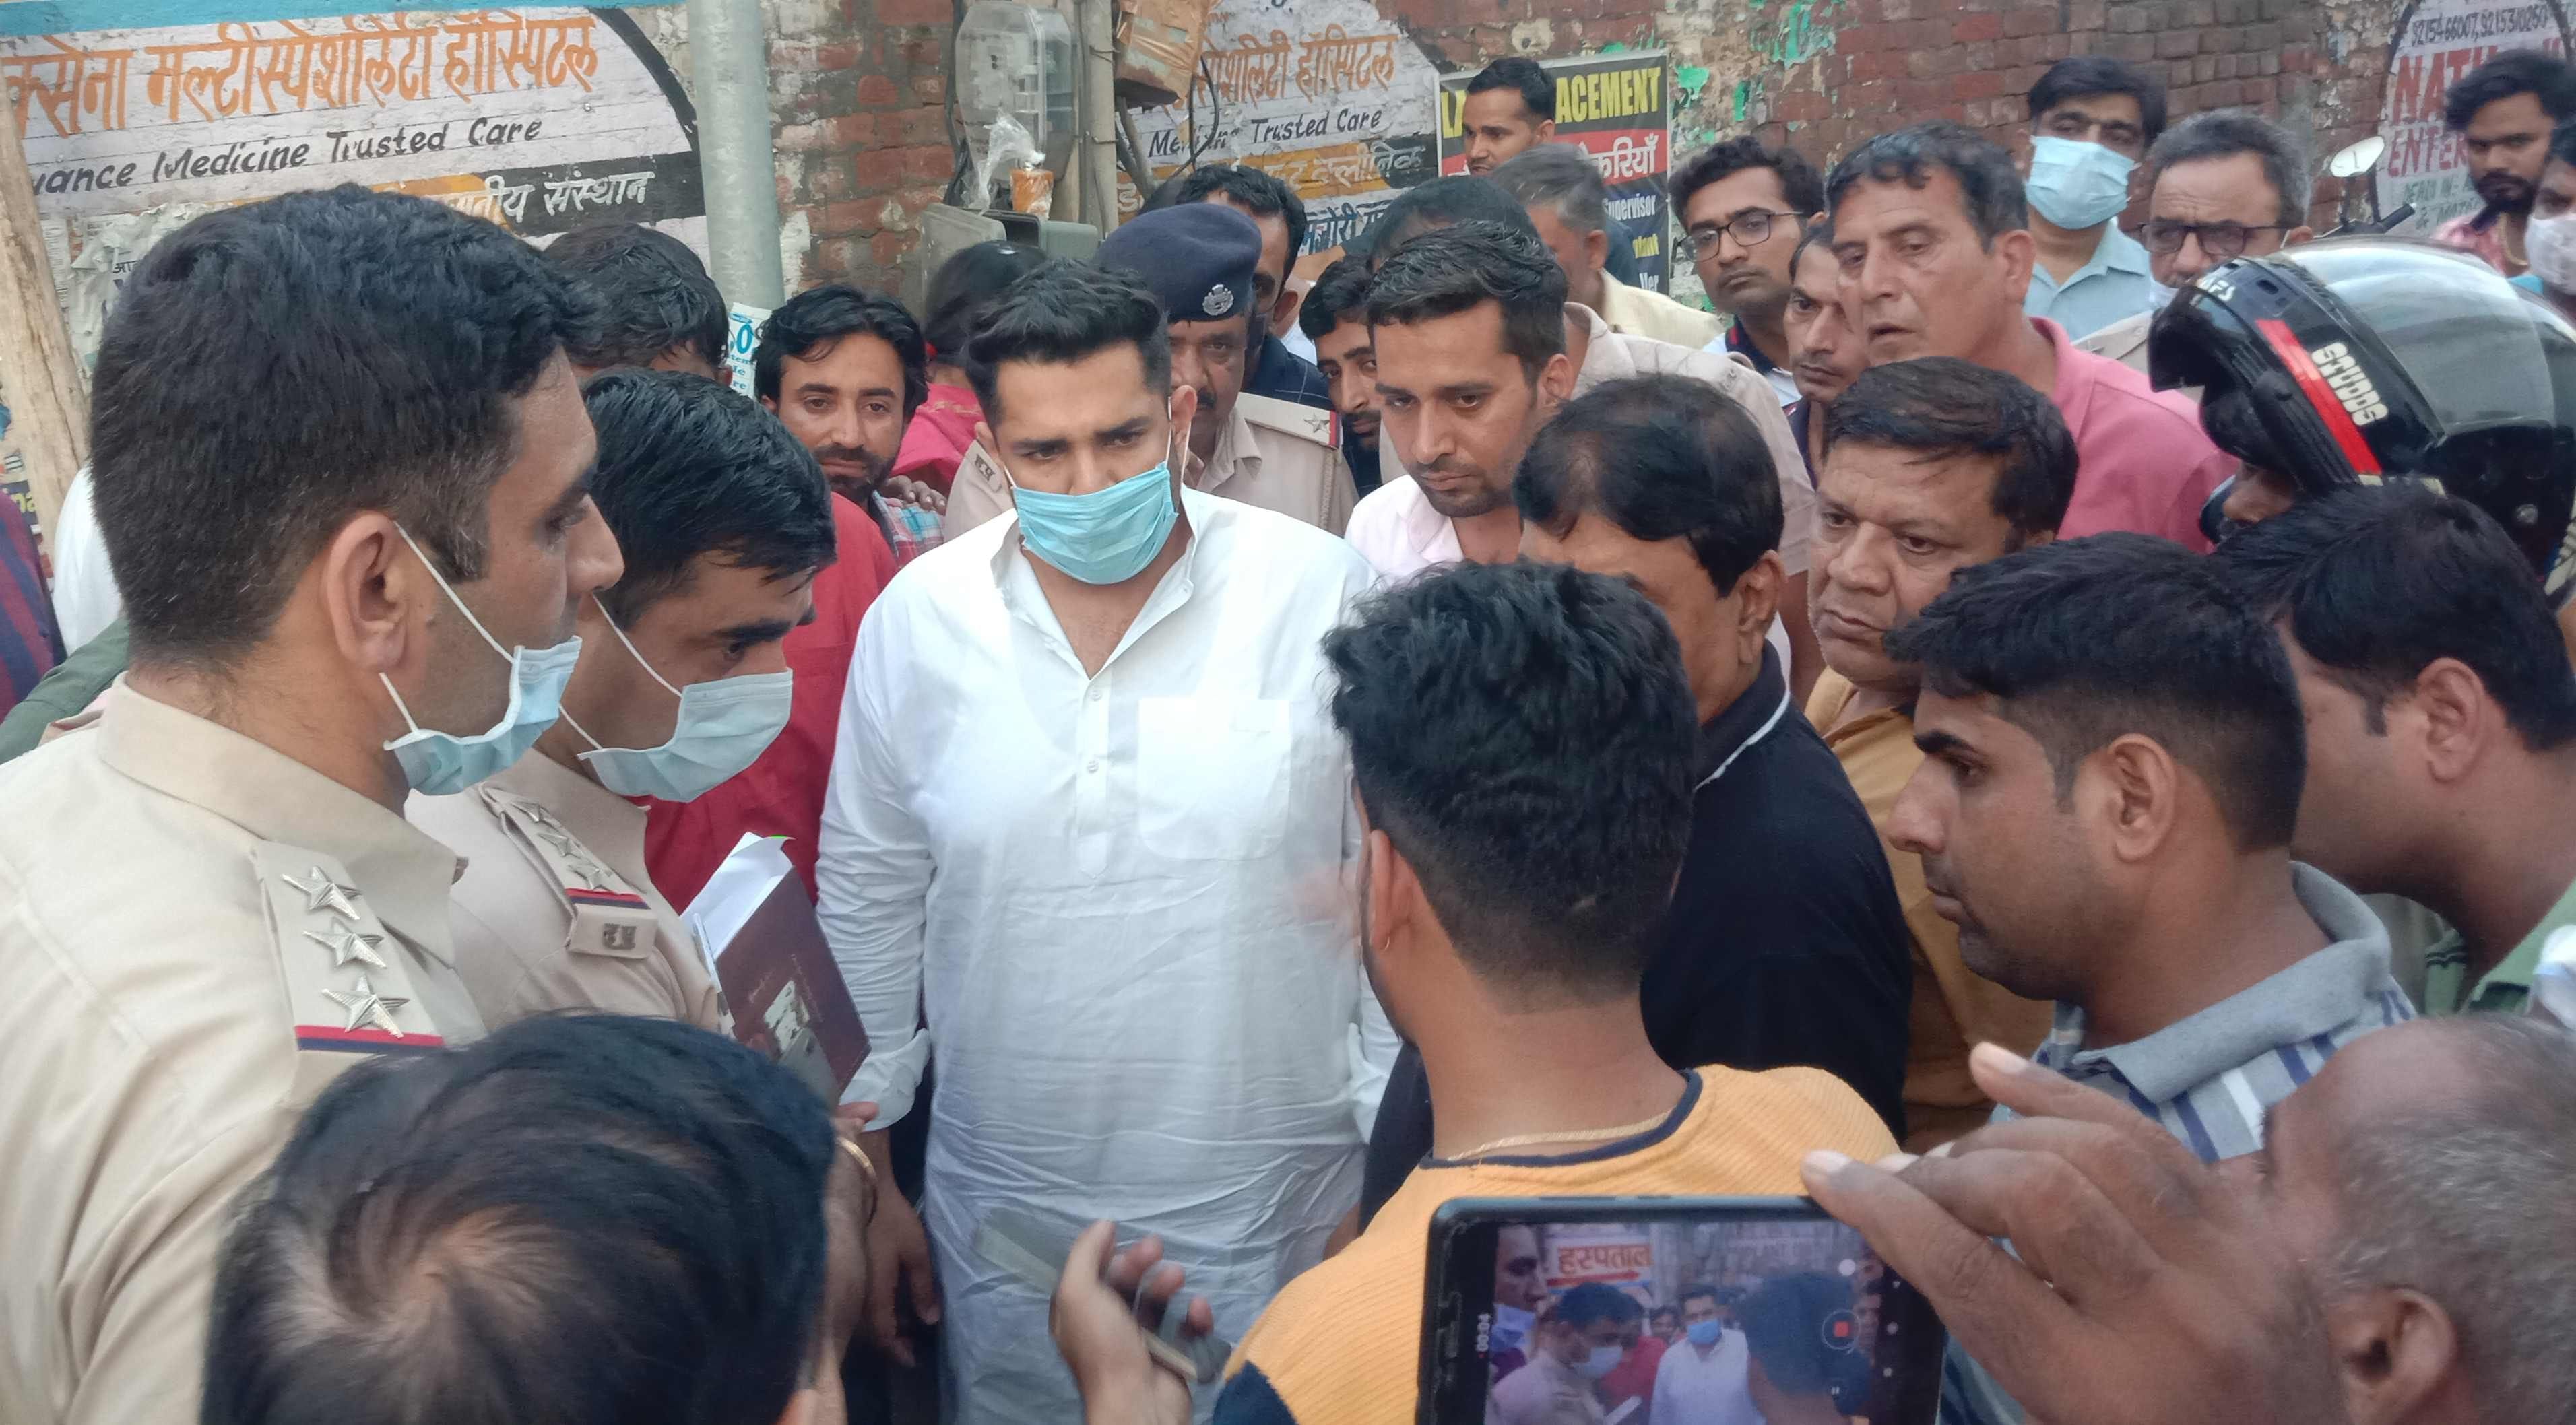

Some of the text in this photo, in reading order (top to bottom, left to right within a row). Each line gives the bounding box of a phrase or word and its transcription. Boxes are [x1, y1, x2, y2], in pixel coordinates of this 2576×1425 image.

[0, 34, 133, 139] क्सेना
[1555, 67, 1661, 124] ACEMENT
[34, 117, 542, 195] vance Medicine Trusted Care
[1251, 111, 1329, 144] Trusted
[1337, 108, 1382, 131] Care
[544, 170, 655, 216] संस्थान
[2312, 342, 2388, 426] STUDDS
